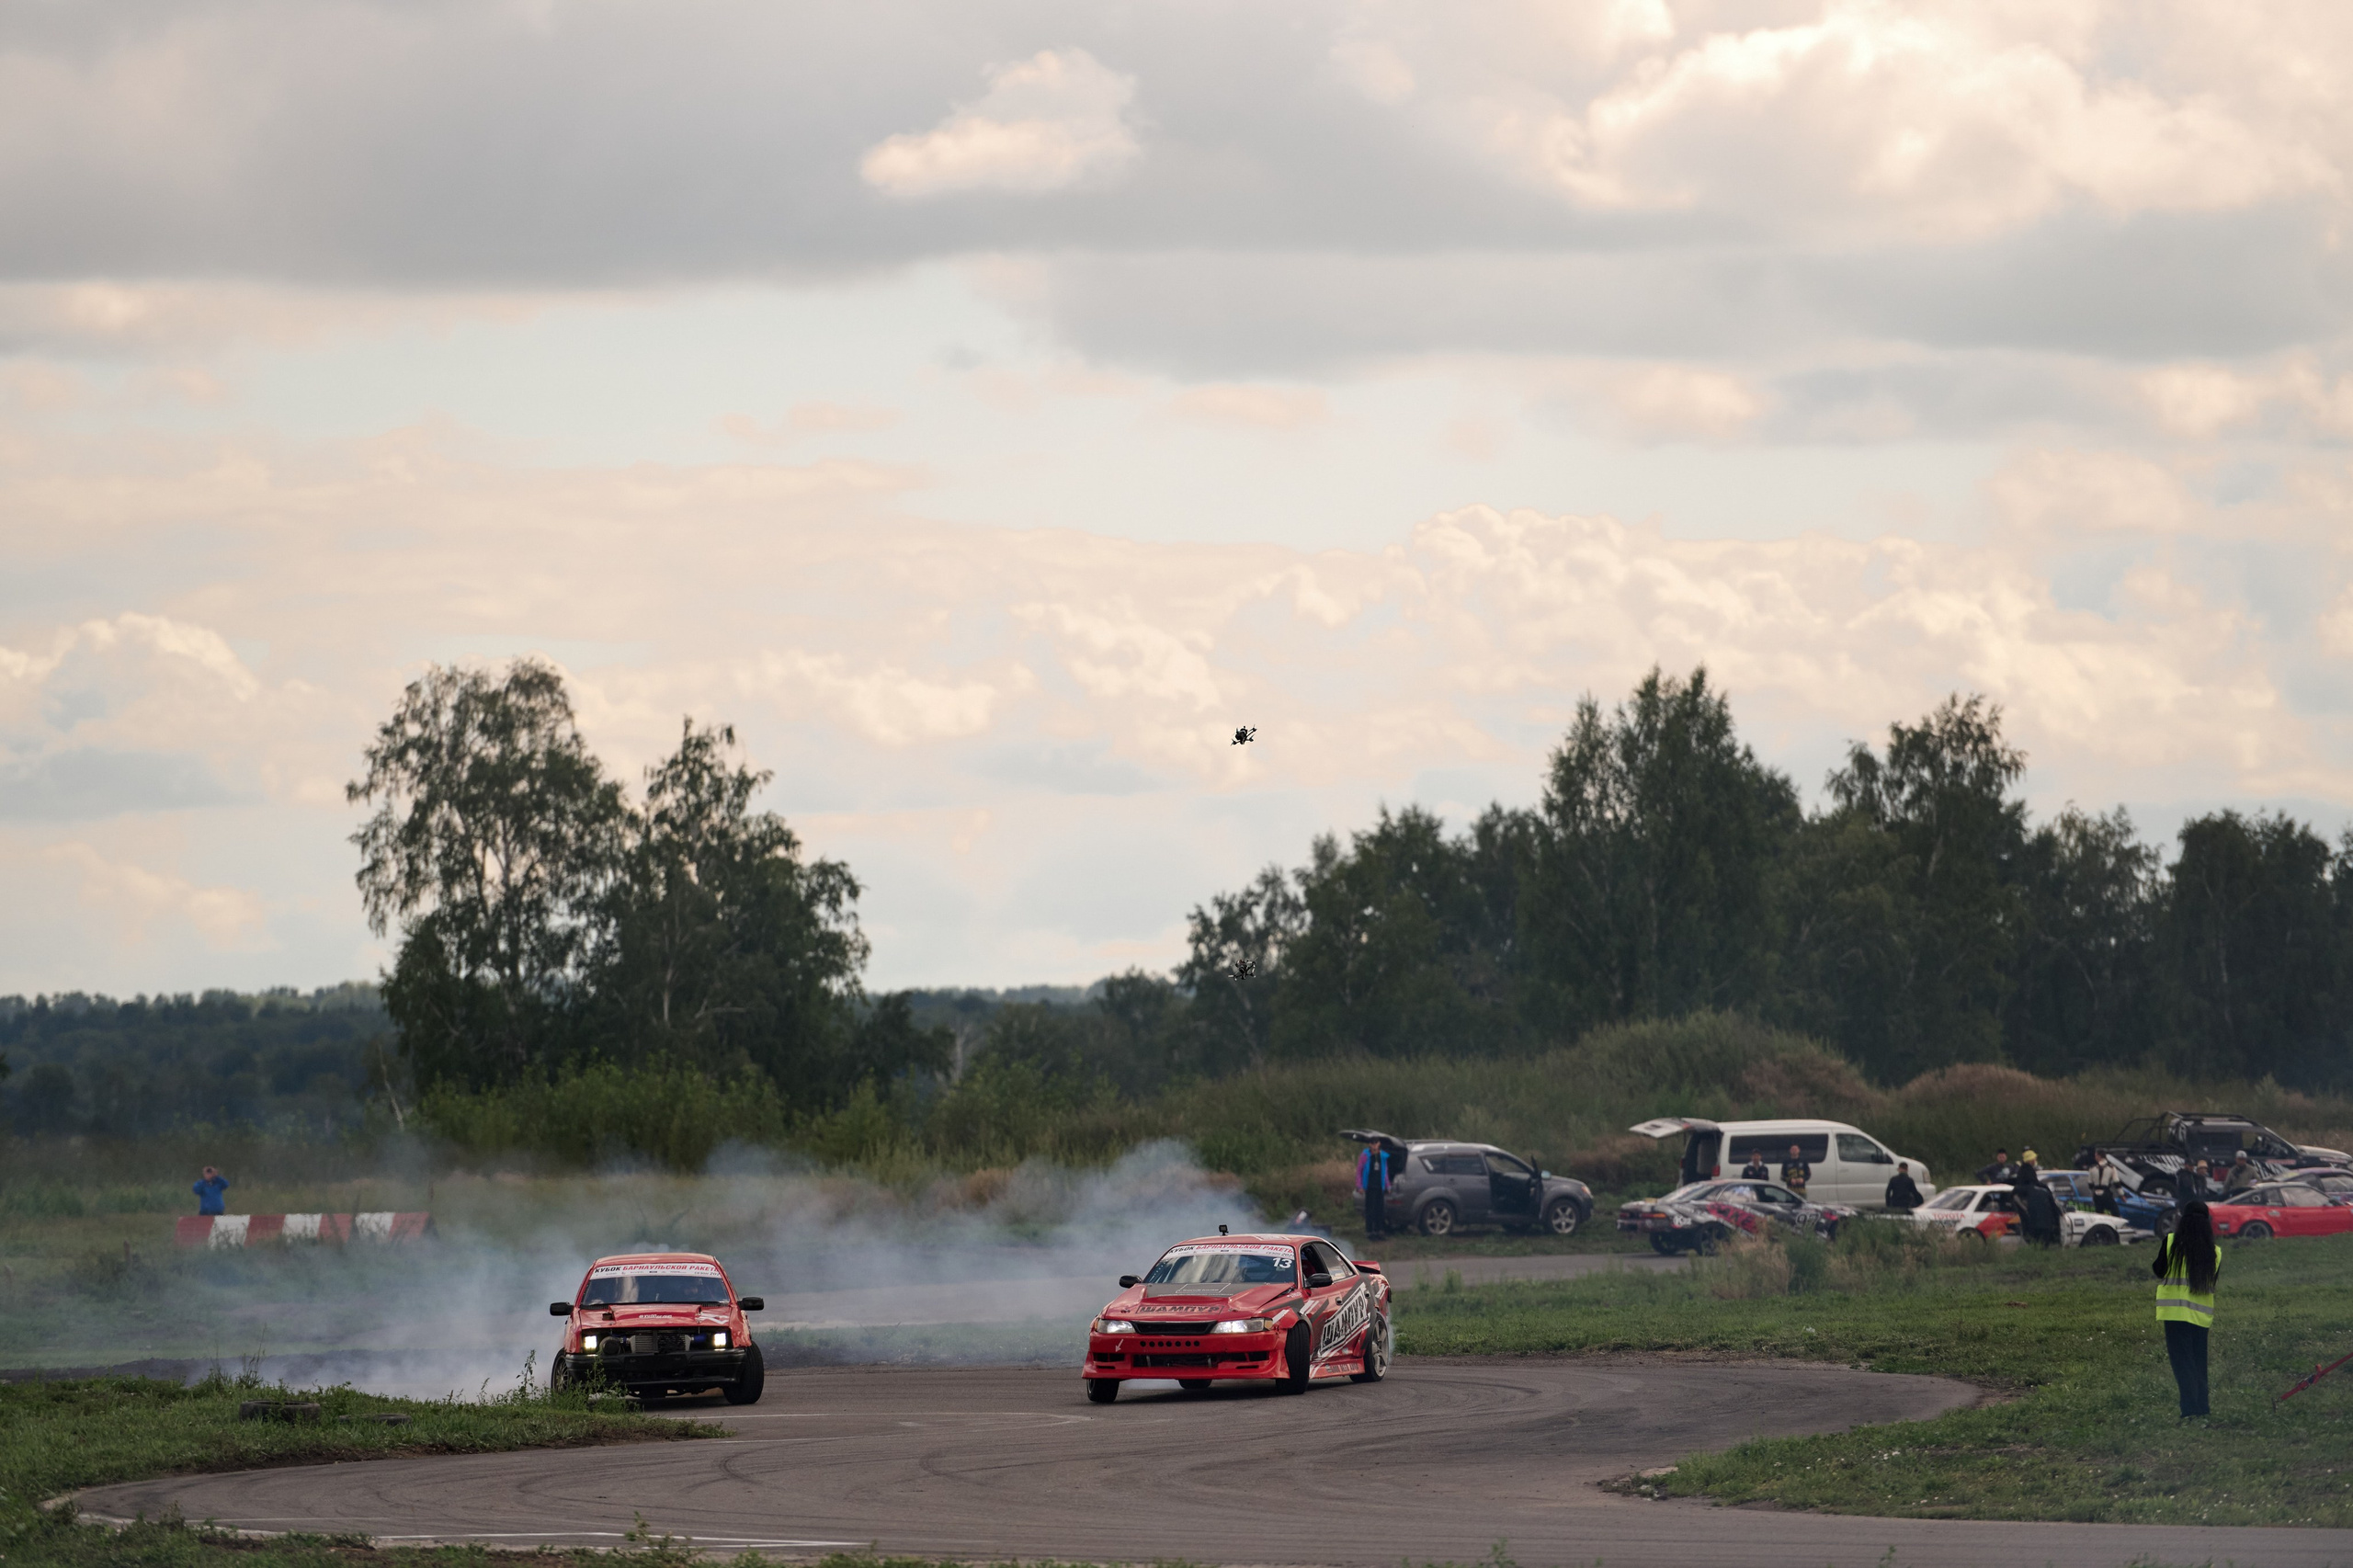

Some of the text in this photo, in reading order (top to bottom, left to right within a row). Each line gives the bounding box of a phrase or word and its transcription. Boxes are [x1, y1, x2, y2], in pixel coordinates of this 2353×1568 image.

[1169, 1245, 1195, 1254] КУБОК
[1272, 1257, 1292, 1268] 13
[595, 1266, 621, 1274] КУБОК
[1324, 1295, 1364, 1346] ШАМПУР
